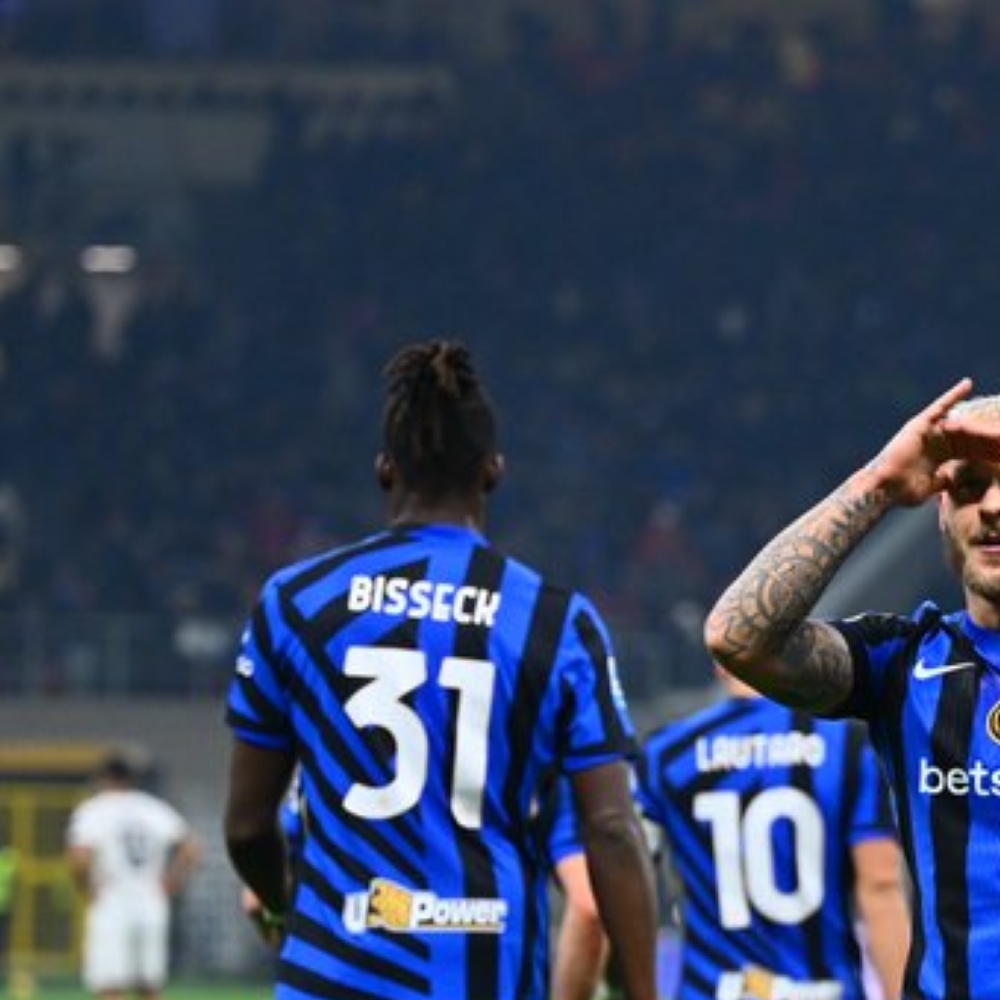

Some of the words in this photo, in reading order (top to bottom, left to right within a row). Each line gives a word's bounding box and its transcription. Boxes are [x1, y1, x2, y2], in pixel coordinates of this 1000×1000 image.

[348, 576, 501, 626] BISSECK
[342, 646, 496, 829] 31
[692, 786, 825, 930] 10
